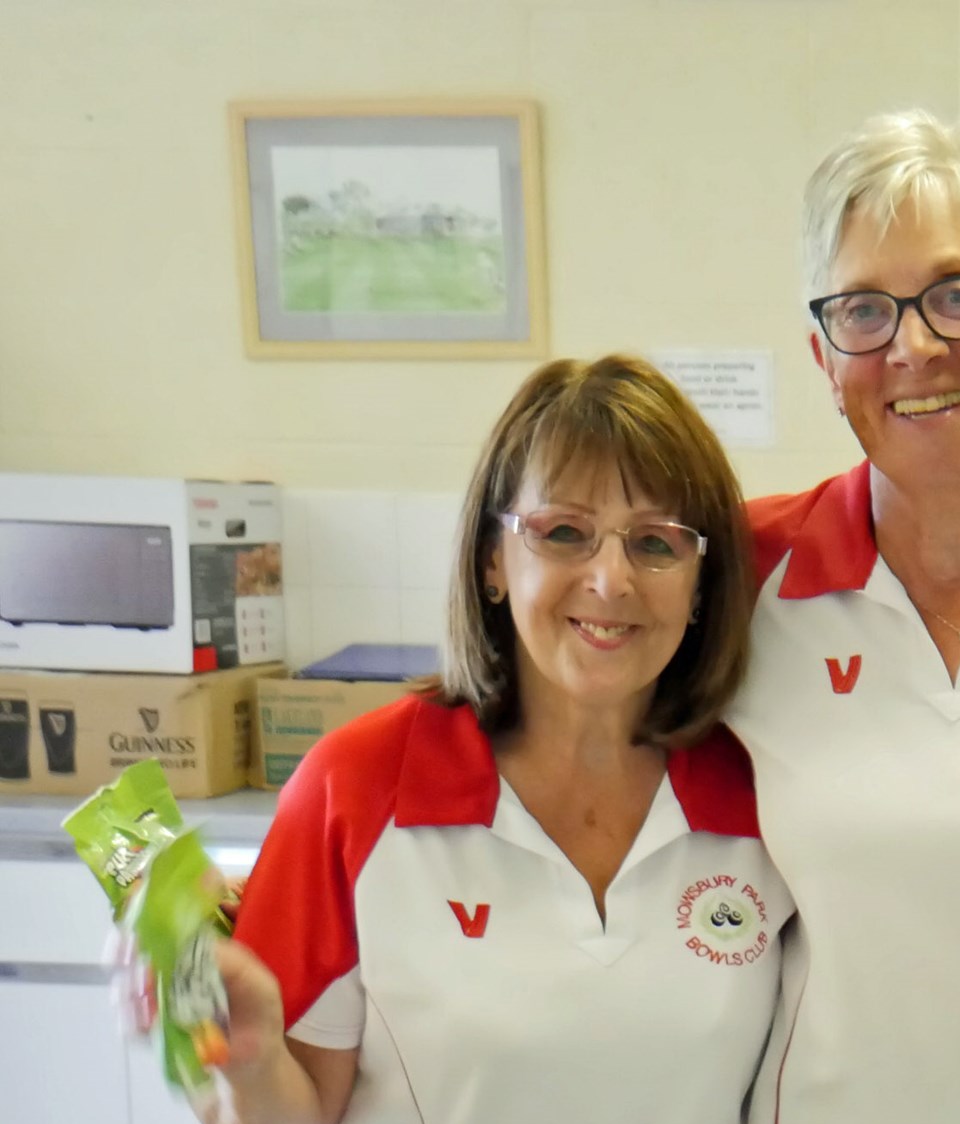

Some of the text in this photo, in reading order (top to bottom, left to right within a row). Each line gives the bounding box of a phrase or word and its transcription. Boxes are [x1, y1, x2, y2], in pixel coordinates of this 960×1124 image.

[108, 732, 196, 753] GUINNESS
[676, 874, 768, 929] MOWSBURY PARK
[685, 930, 768, 966] BOWLS CLUB
